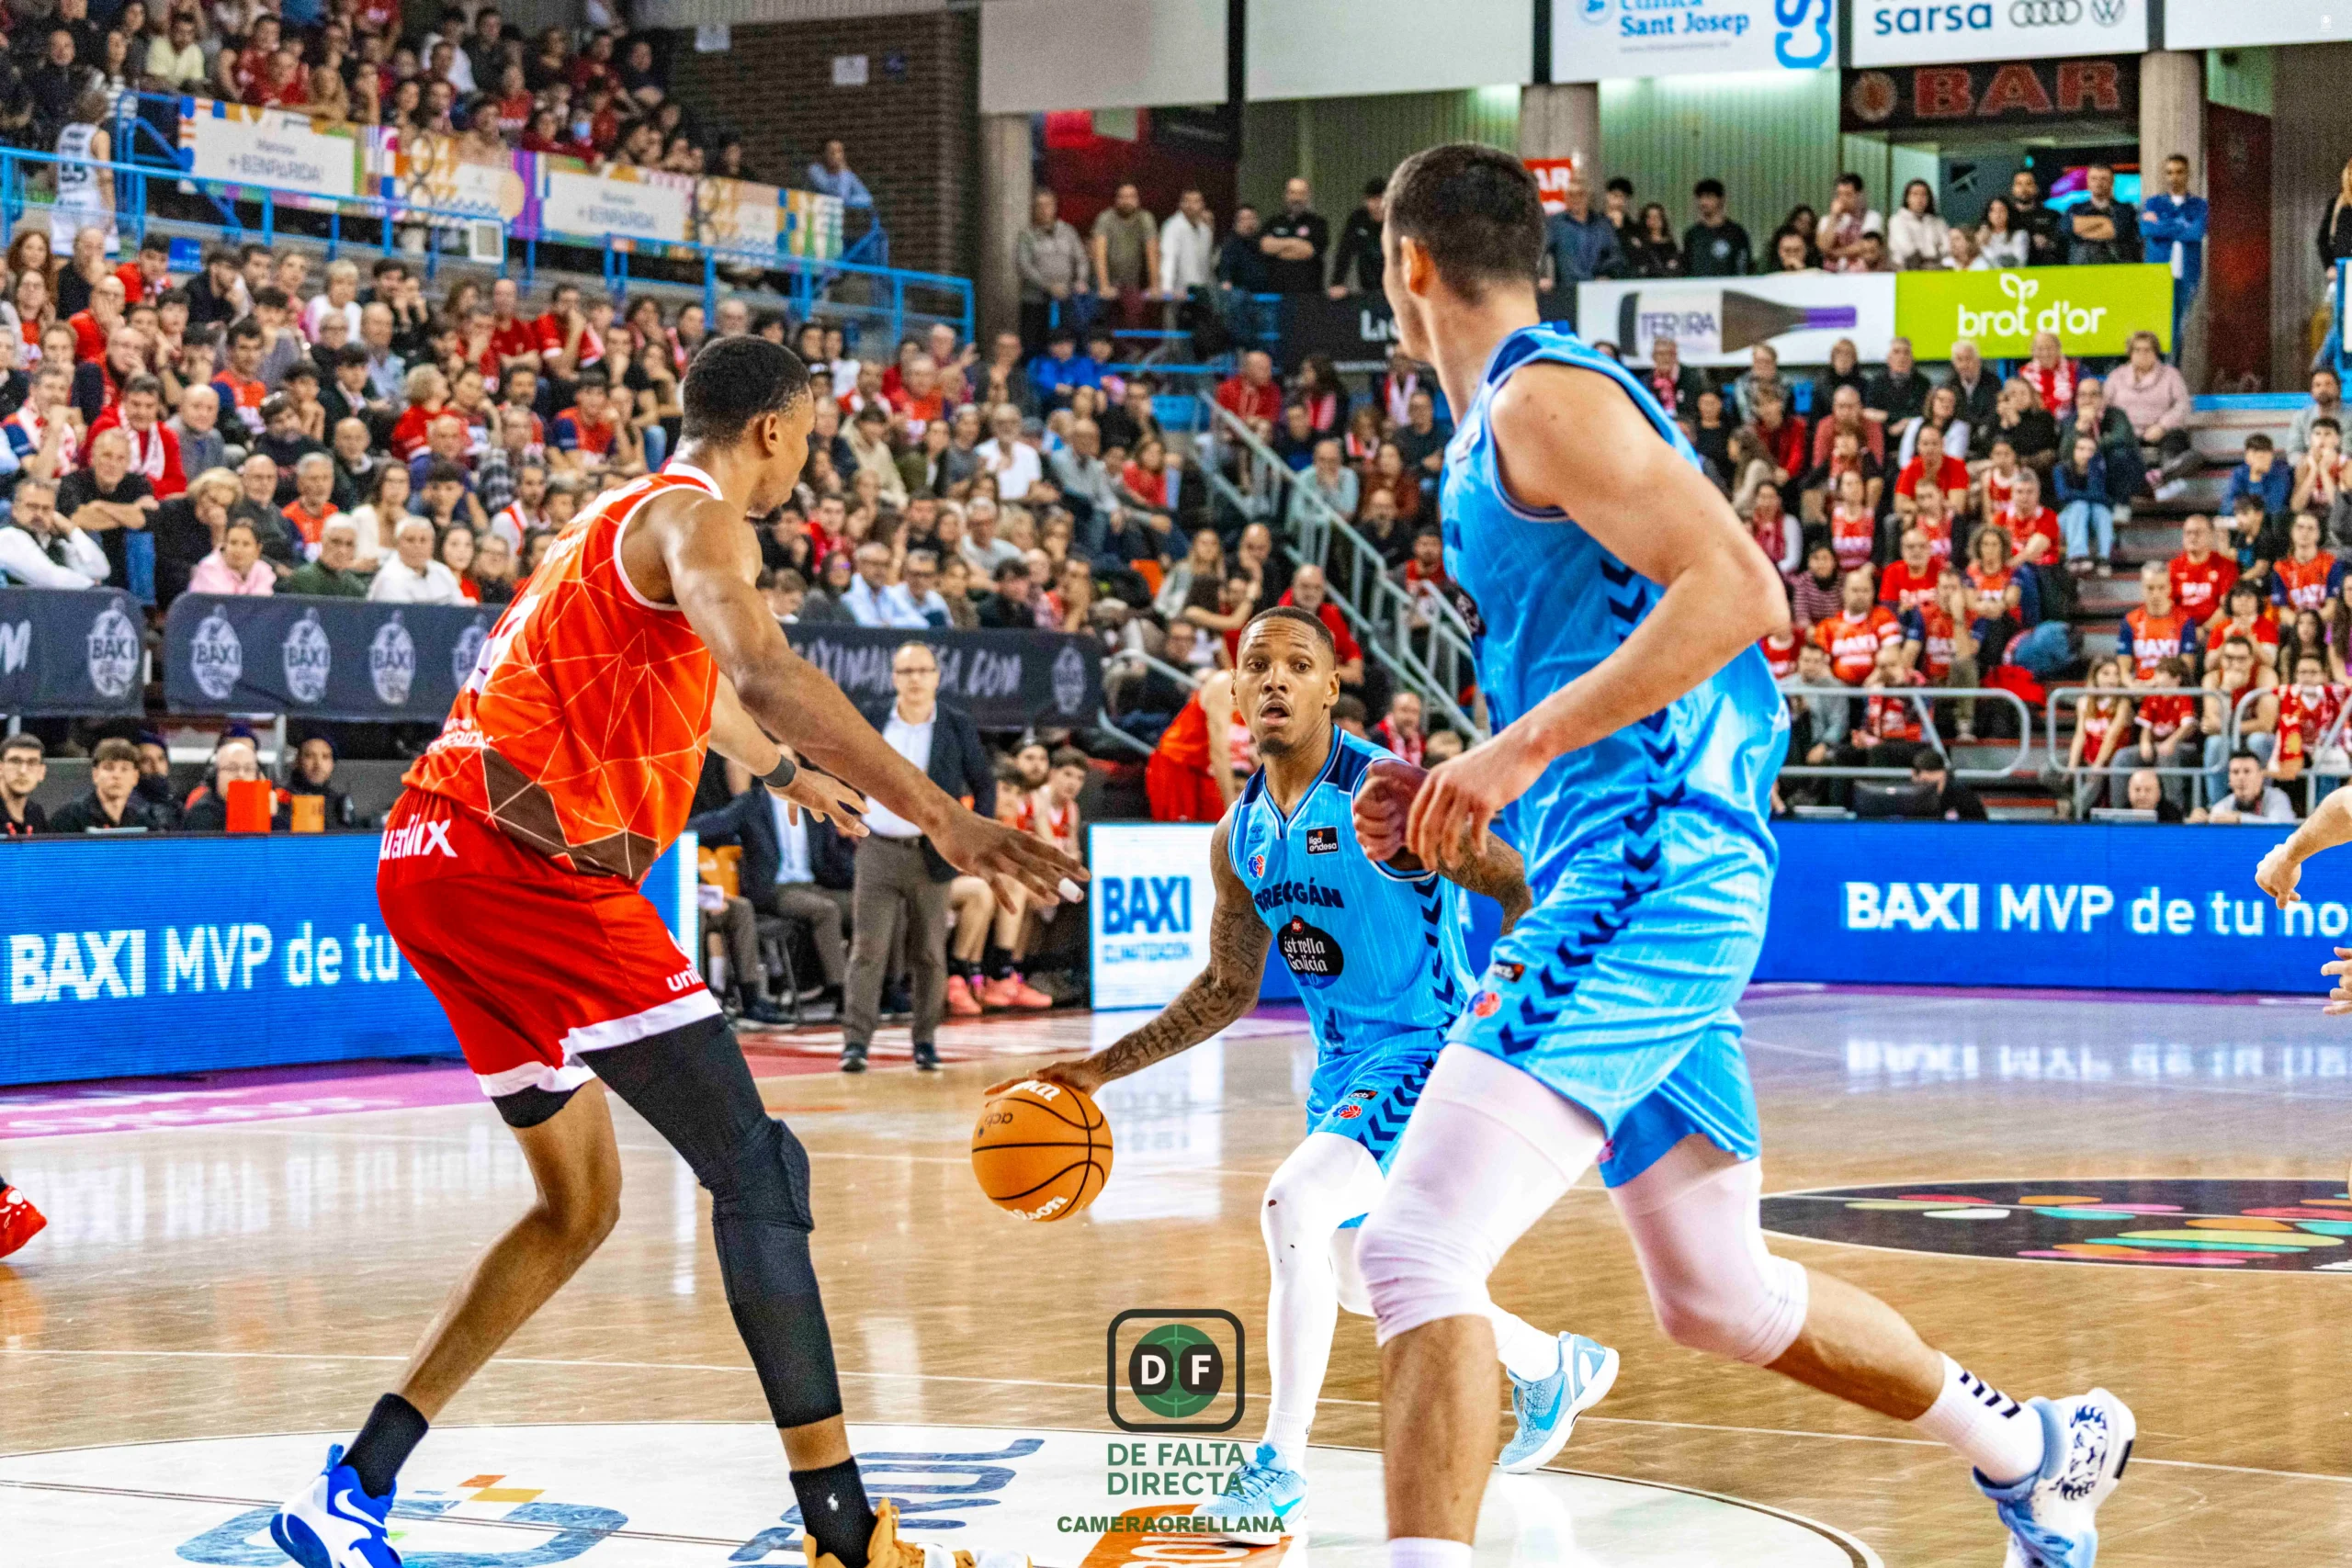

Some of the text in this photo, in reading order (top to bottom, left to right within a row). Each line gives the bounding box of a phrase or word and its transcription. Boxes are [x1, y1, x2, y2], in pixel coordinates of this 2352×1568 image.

[1620, 11, 1749, 37] Sant Josep
[1874, 2, 1993, 35] sarsa
[1914, 61, 2120, 117] BAR
[1958, 300, 2107, 337] brot d'or
[92, 637, 138, 660] BAXI
[1308, 837, 1322, 845] liga
[1309, 843, 1338, 852] endesa
[1102, 876, 1191, 934] BAXI
[1845, 882, 1980, 931] BAXI
[1998, 884, 2113, 932] MVP
[2131, 886, 2195, 934] de
[2211, 890, 2266, 936] tu
[8, 921, 401, 1004] BAXI MVP de tu
[984, 1111, 1013, 1127] acb
